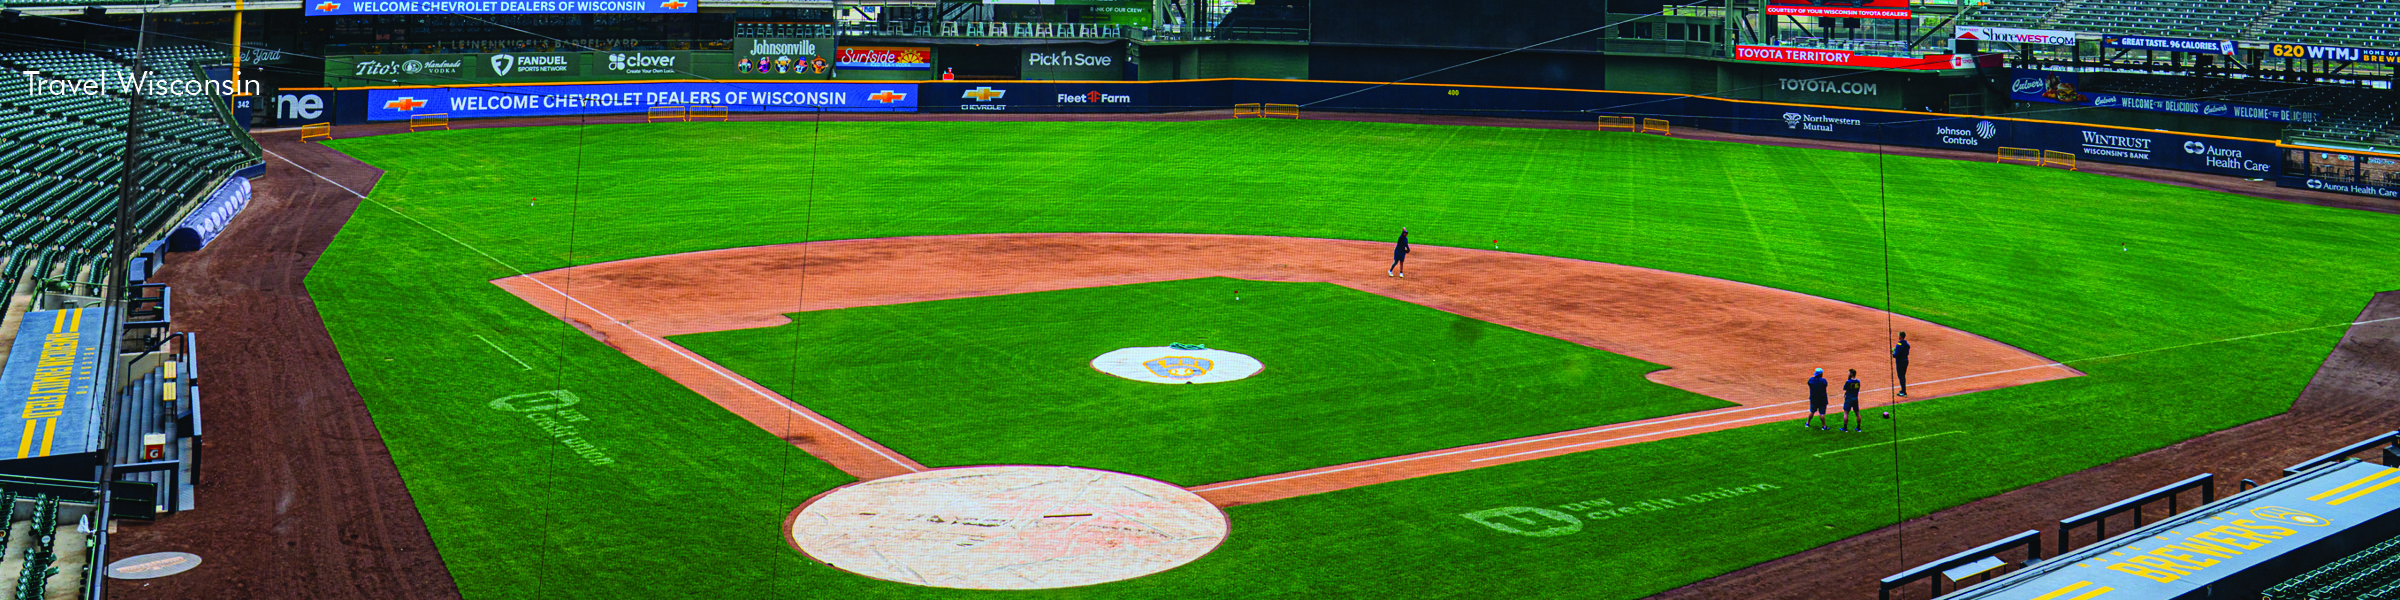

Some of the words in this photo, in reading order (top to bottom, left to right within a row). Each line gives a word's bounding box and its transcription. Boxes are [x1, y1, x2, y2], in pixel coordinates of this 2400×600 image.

[353, 2, 418, 12] WELCOME
[421, 2, 498, 12] CHEVROLET
[500, 2, 556, 11] DEALERS
[558, 2, 575, 11] OF
[577, 1, 645, 11] WISCONSIN
[750, 40, 815, 56] Johnsonville
[2121, 37, 2144, 46] GREAT
[2145, 39, 2169, 47] TASTE.
[2169, 40, 2180, 48] 96
[2181, 41, 2219, 51] CALORIES.
[252, 48, 281, 65] Yard
[841, 48, 896, 65] Surfside
[1028, 52, 1060, 66] Pick
[1074, 53, 1111, 66] Save
[1738, 48, 1783, 59] TOYOTA
[1785, 50, 1851, 62] TERRITORY
[2272, 44, 2304, 57] 620
[2306, 45, 2359, 60] WTMJ
[424, 60, 461, 69] Handmade
[517, 56, 567, 66] FANDUEL
[626, 52, 676, 67] clover
[1778, 78, 1877, 95] TOYOTA.COM
[2011, 77, 2044, 93] Culver's
[237, 100, 250, 108] 342
[450, 95, 539, 111] WELCOME
[543, 93, 643, 108] CHEVROLET
[646, 91, 720, 105] DEALERS
[724, 91, 748, 105] OF
[751, 91, 847, 105] WISCONSIN
[1058, 93, 1087, 103] Fleet
[1101, 93, 1130, 103] Farm
[2095, 95, 2117, 106] Culver's
[2121, 97, 2154, 110] WELCOME
[2165, 100, 2198, 113] DELICIOUS
[2203, 104, 2228, 115] Culver's
[2233, 106, 2269, 120] WELCOME
[1803, 114, 1861, 125] Northwestern
[1803, 122, 1833, 132] Mutual
[1936, 126, 1971, 136] Johnson
[1942, 135, 1978, 146] Controls
[2081, 130, 2151, 149] WINTRUST
[2083, 147, 2128, 158] WISCONSIN'S
[2129, 152, 2149, 160] BANK
[2206, 145, 2242, 158] Aurora
[2206, 155, 2241, 169] Health
[2244, 159, 2269, 172] Care
[2323, 182, 2348, 192] Aurora
[2351, 185, 2376, 195] Health
[2378, 187, 2398, 198] Care
[149, 449, 158, 458] G
[2104, 518, 2299, 584] BREWERS
